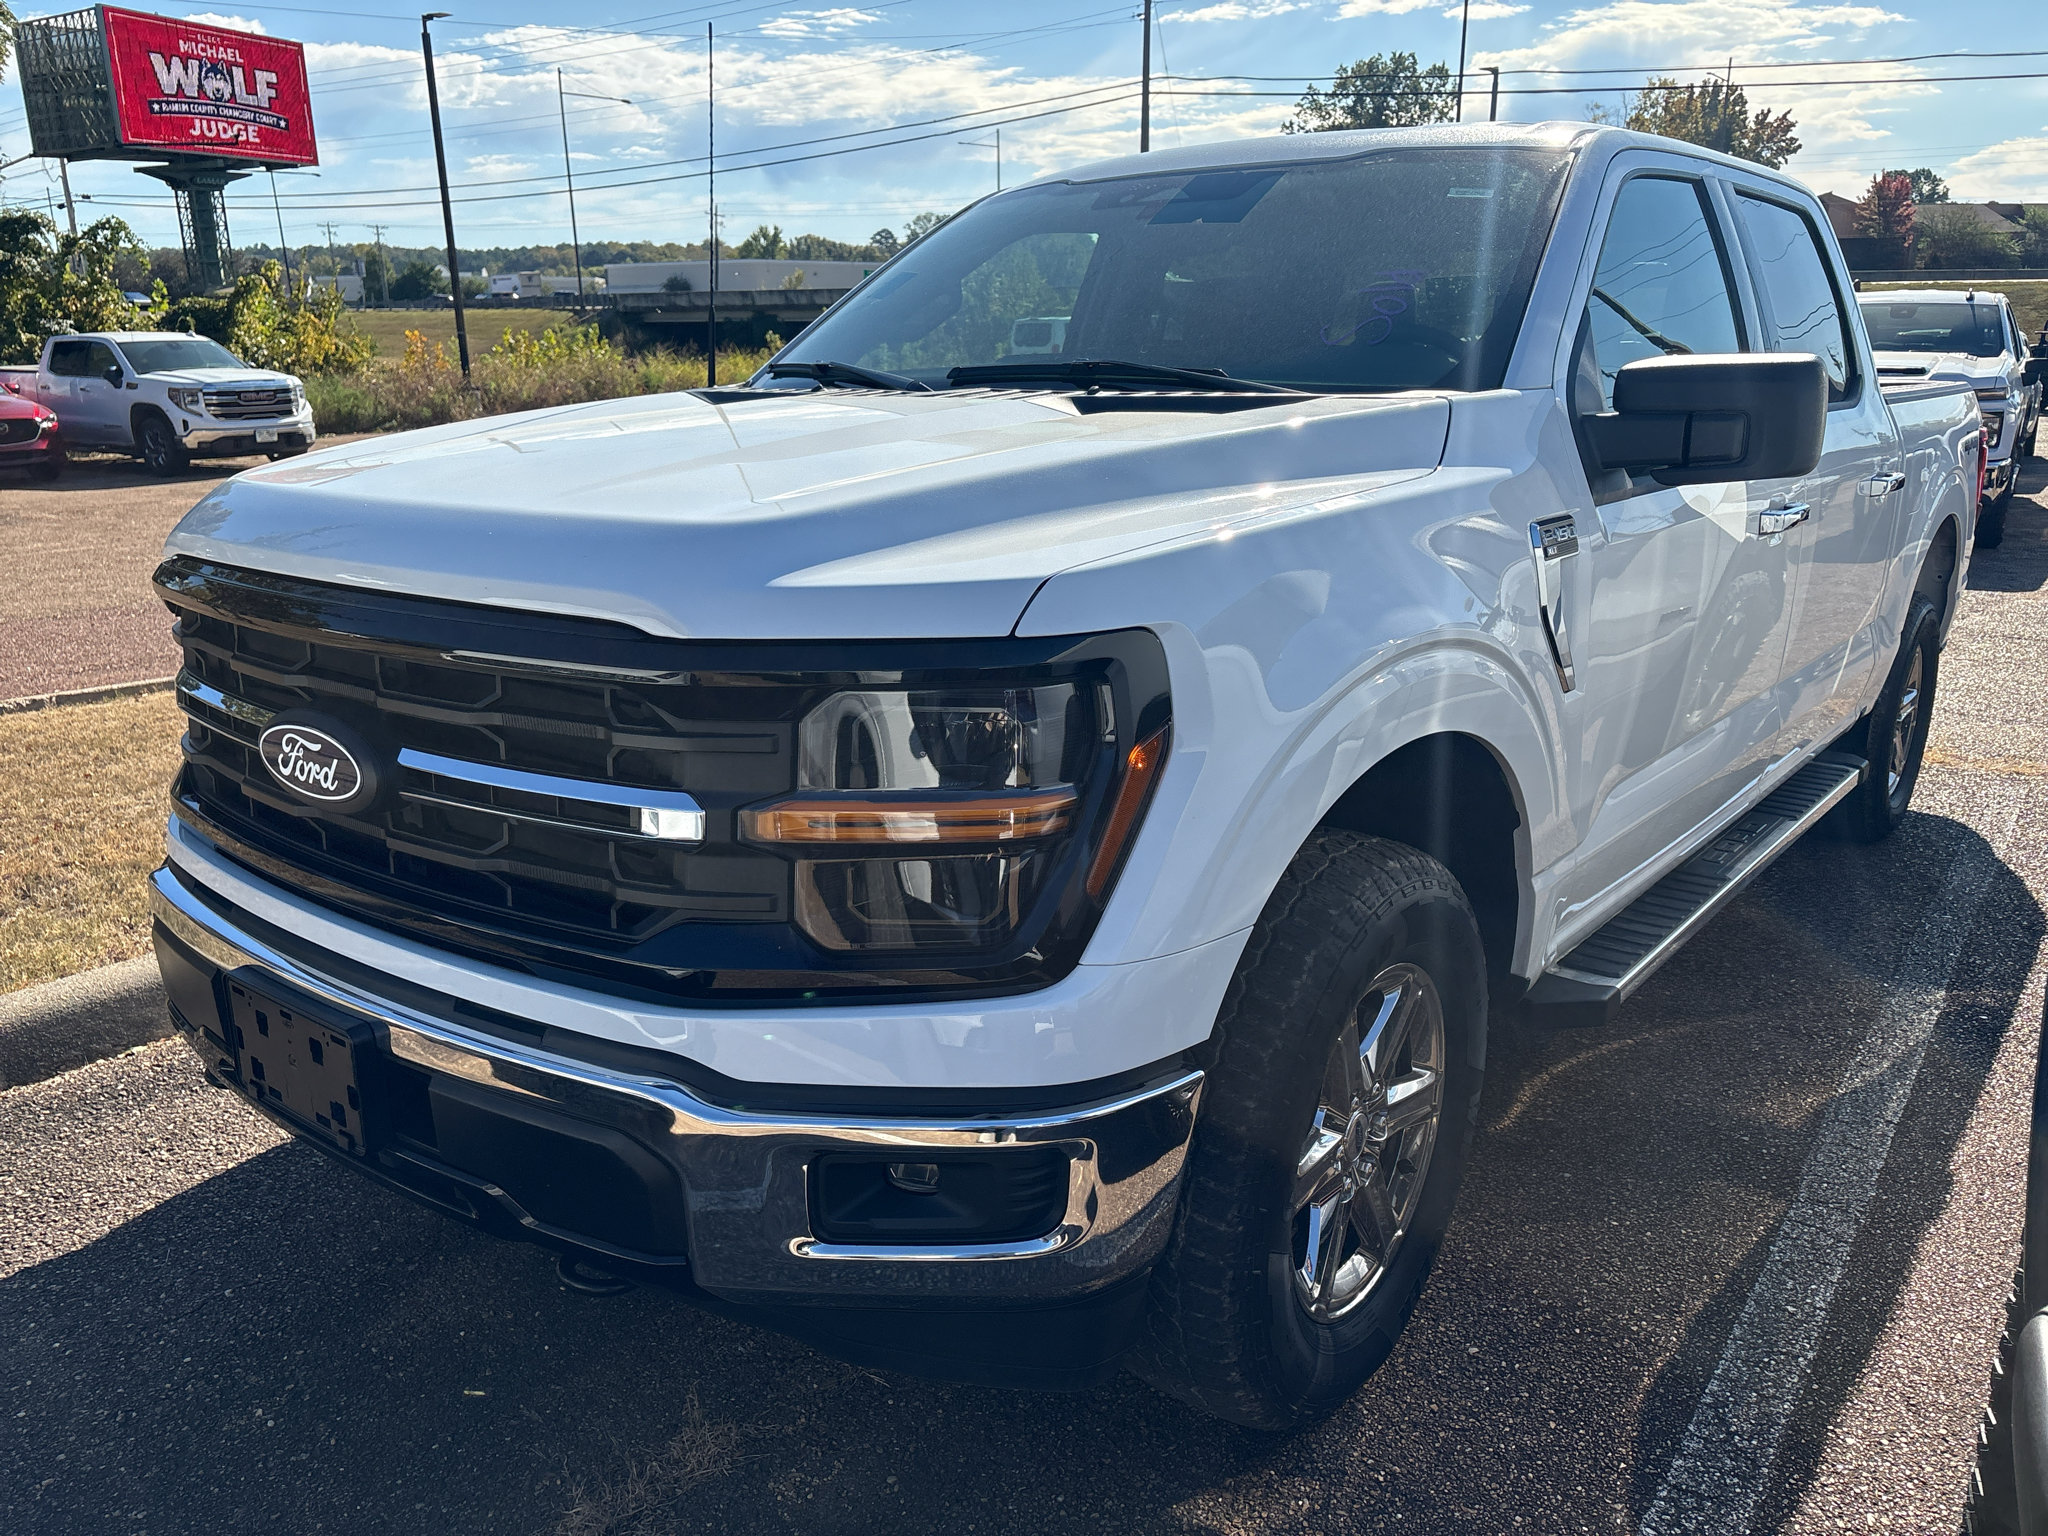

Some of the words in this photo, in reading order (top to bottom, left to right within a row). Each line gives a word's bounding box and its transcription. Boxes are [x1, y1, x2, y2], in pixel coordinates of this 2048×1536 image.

[179, 39, 244, 63] MICHAEL
[190, 104, 217, 115] COUNTY
[219, 106, 254, 121] CHANCERY
[255, 112, 278, 126] COURT
[189, 119, 260, 142] JUDGE
[240, 391, 275, 401] GMC
[1547, 546, 1558, 556] XLT
[278, 733, 338, 791] Ford
